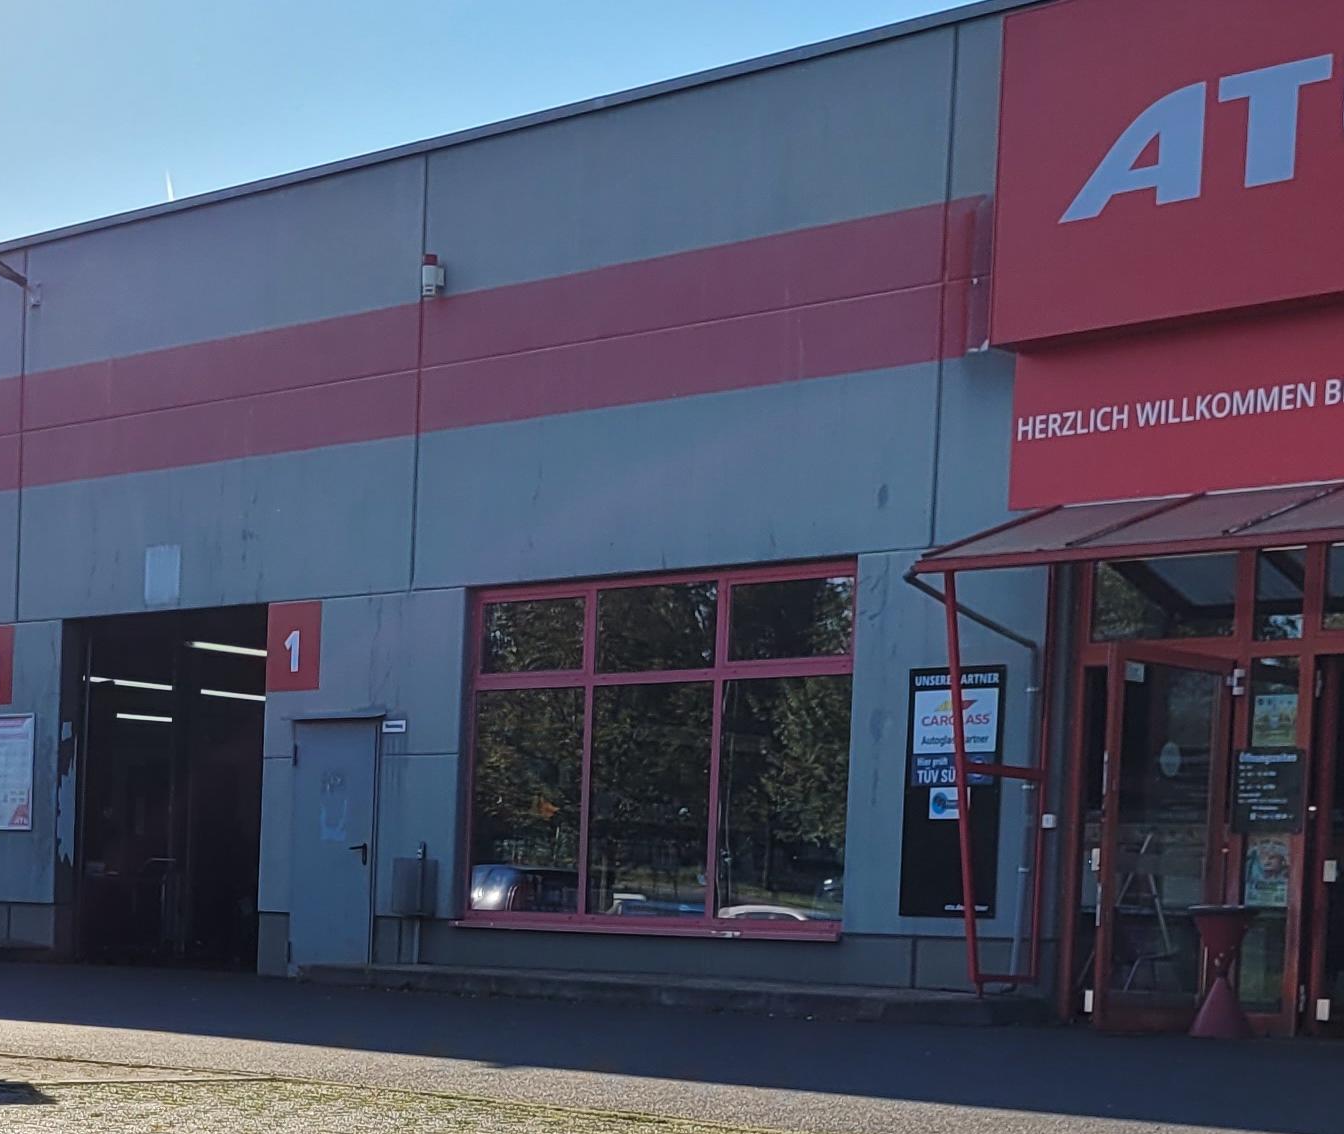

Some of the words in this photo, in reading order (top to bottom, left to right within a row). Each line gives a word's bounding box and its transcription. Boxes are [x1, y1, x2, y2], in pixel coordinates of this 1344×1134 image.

[1017, 404, 1129, 442] HERZLICH
[1136, 382, 1316, 428] WILLKOMMEN
[284, 630, 300, 673] 1
[960, 673, 999, 684] ARTNER
[922, 713, 990, 726] CARGASS
[917, 767, 939, 783] TÜV
[941, 766, 956, 783] SÜ
